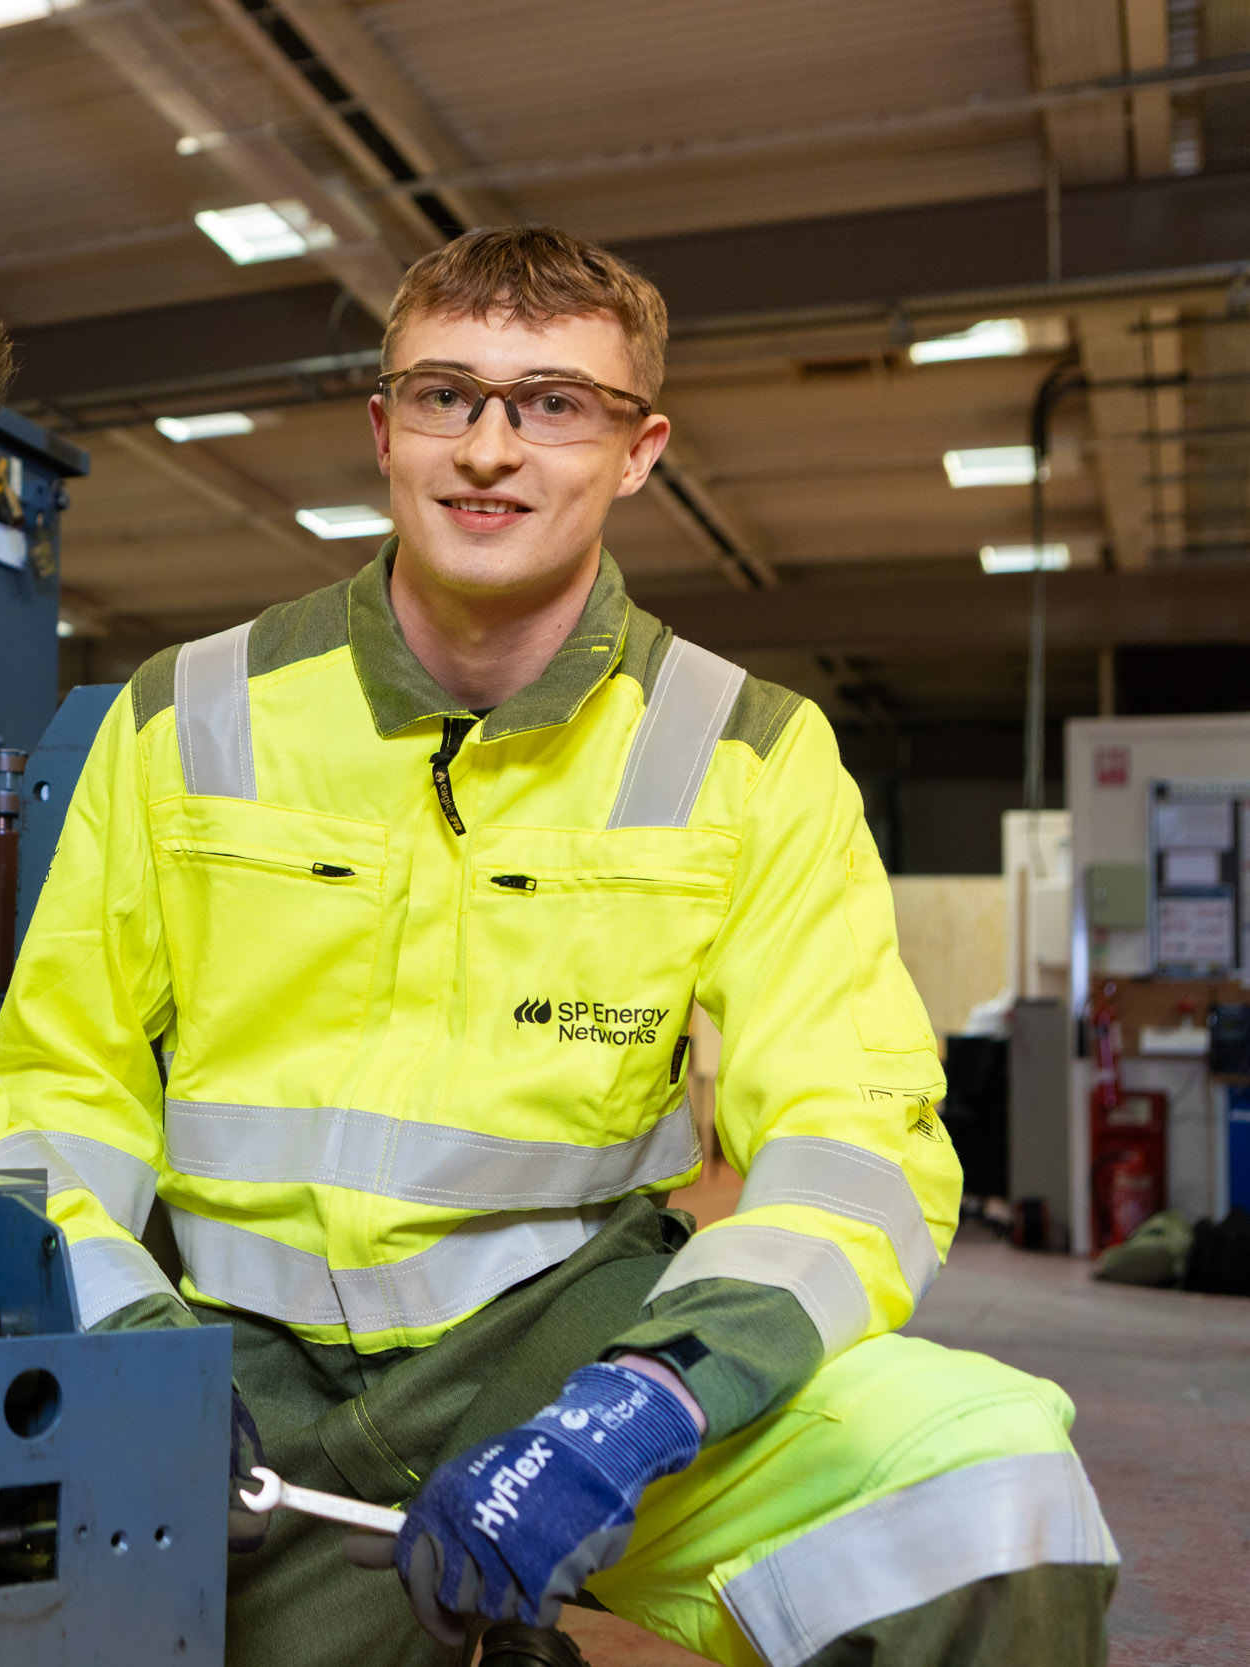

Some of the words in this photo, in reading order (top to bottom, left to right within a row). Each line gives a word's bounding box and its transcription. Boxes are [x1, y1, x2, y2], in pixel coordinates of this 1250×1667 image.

[558, 1001, 589, 1022] SP
[593, 1002, 670, 1028] Energy
[558, 1023, 657, 1046] Networks
[470, 1438, 554, 1541] HyFlex
